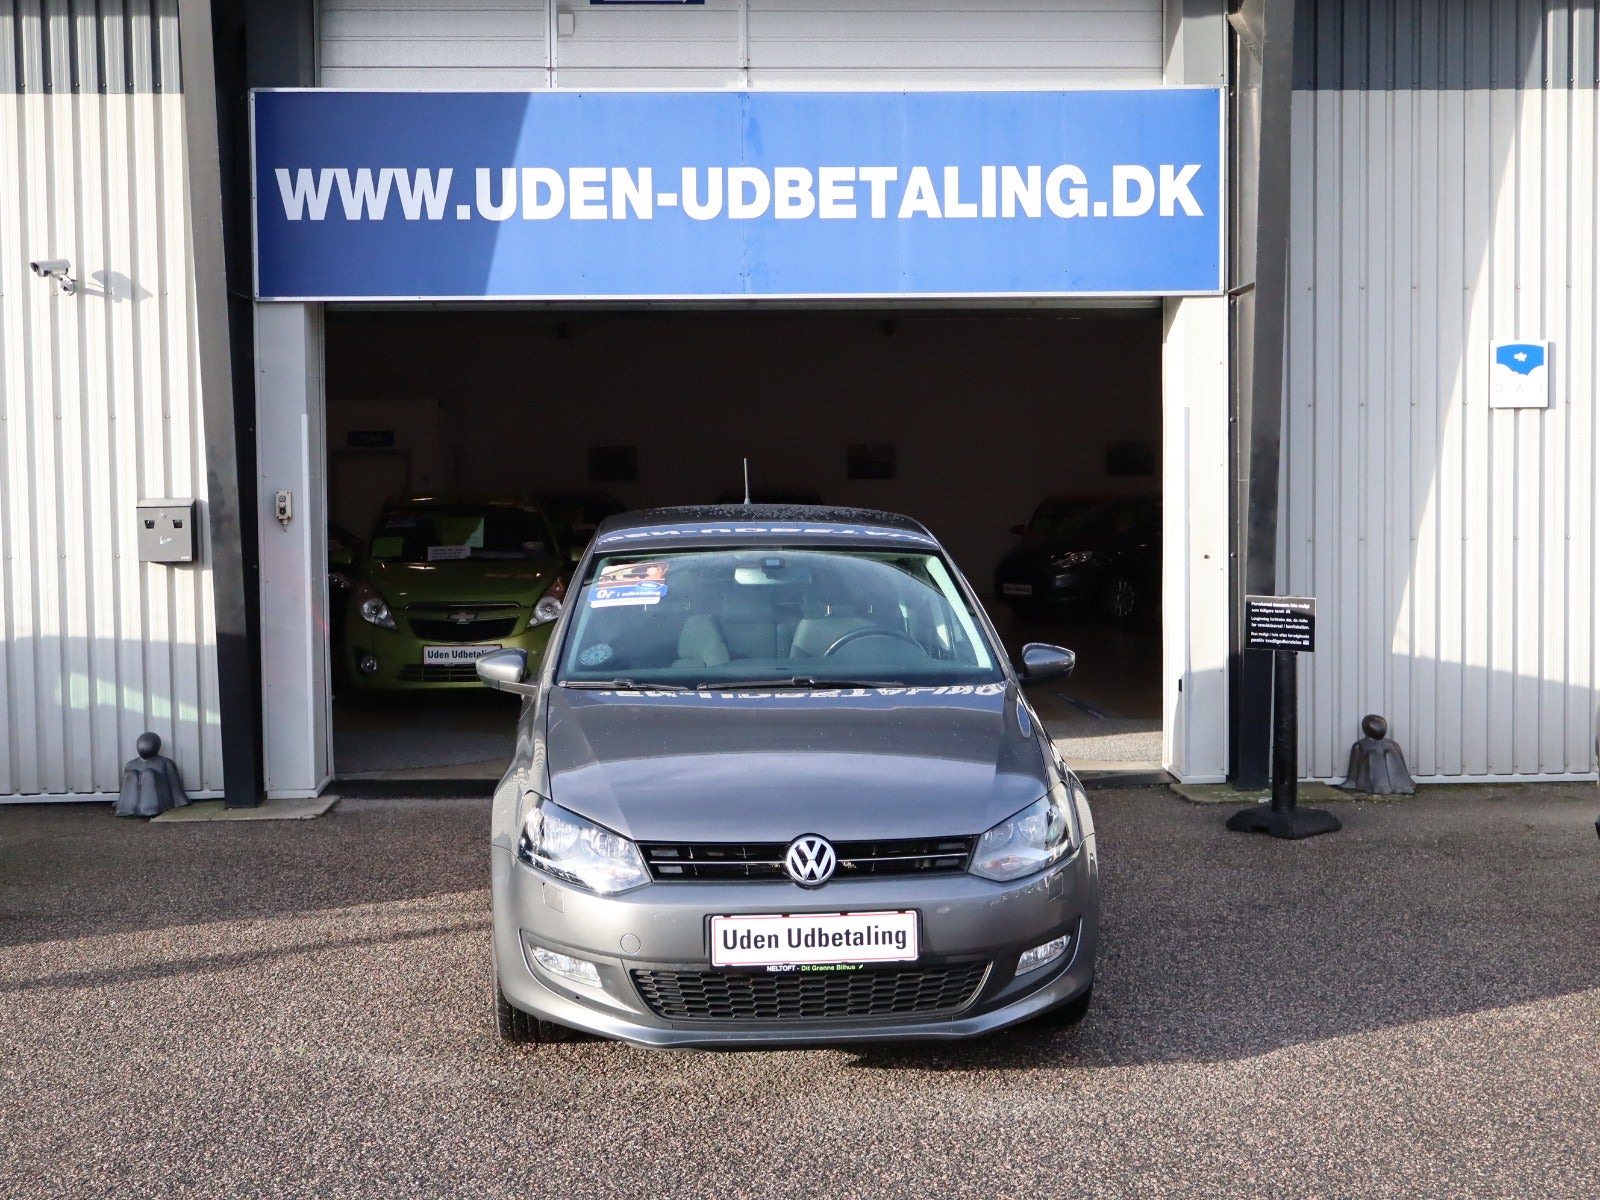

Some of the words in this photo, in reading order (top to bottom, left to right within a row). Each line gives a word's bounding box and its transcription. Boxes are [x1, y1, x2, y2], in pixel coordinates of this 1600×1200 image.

[274, 164, 1205, 221] WWW.UDEN-UDBETALING.DK
[427, 650, 450, 659] Uden
[723, 928, 779, 950] Uden
[787, 925, 907, 950] Udbetaling
[766, 964, 796, 972] NELTOFT
